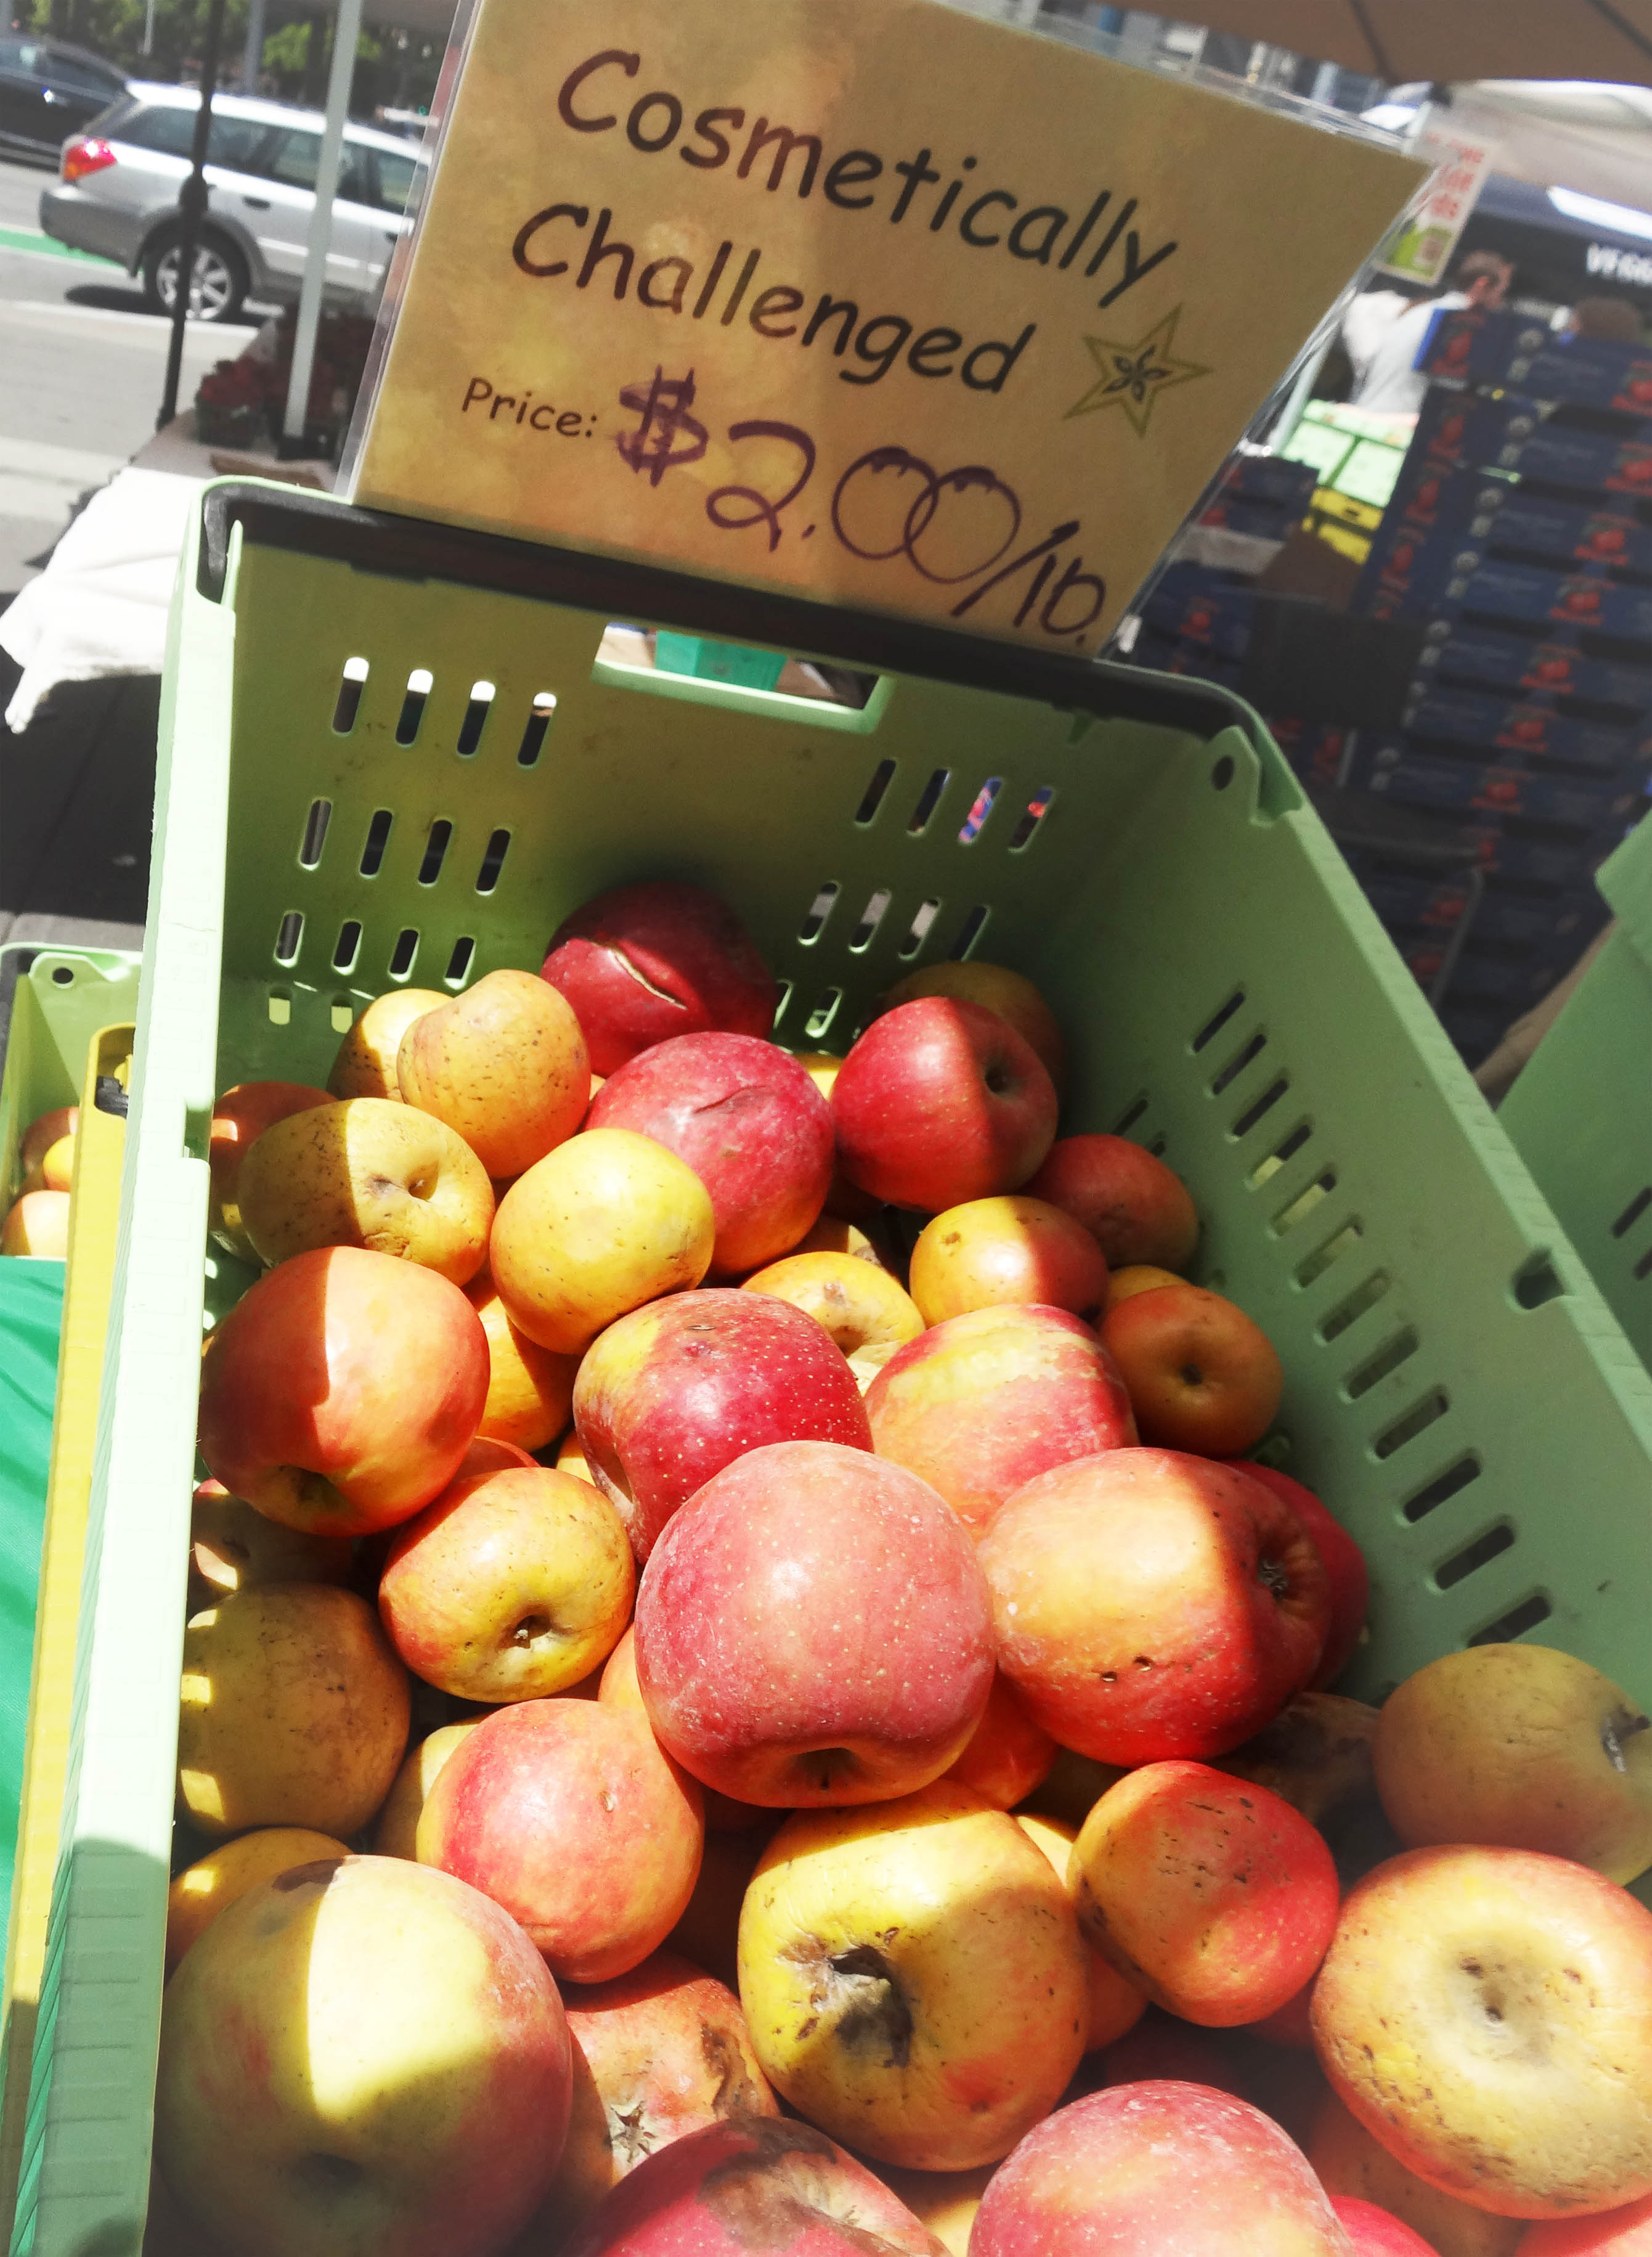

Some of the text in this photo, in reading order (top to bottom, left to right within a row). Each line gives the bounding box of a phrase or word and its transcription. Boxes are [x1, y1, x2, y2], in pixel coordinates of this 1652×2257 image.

[557, 49, 1178, 307] Cosmetically
[511, 203, 1036, 396] Challenged
[462, 377, 598, 438] Price:
